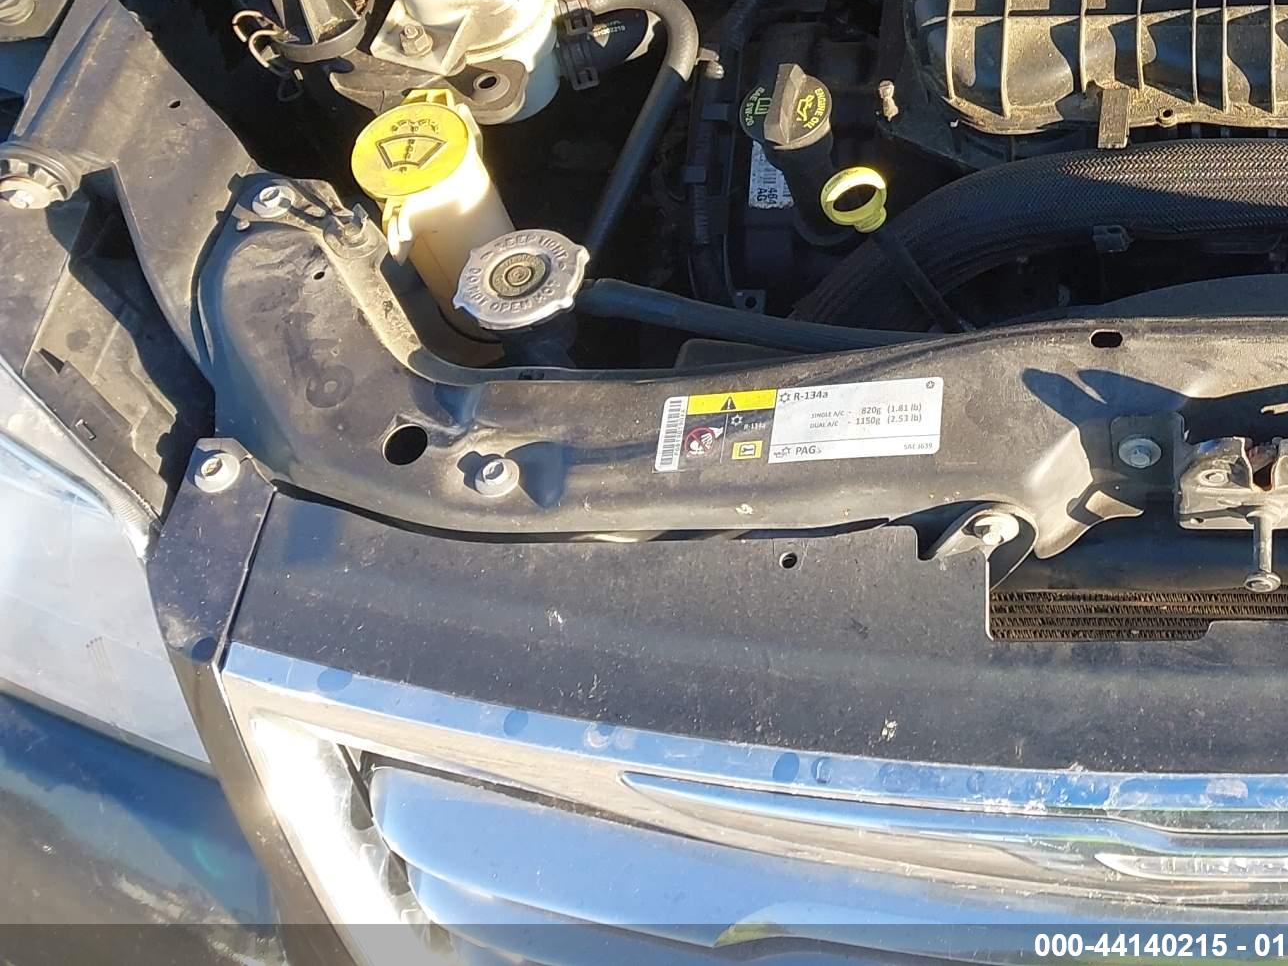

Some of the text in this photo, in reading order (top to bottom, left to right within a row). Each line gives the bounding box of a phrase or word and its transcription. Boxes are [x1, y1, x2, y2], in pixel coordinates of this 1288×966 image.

[744, 102, 755, 127] 5W-20
[803, 87, 828, 130] ENGINE OIL
[494, 233, 569, 260] KEEP TIGHT
[489, 301, 533, 314] OPEN
[793, 390, 829, 402] R-134a
[861, 406, 882, 416] 820g
[855, 417, 881, 426] 1150g
